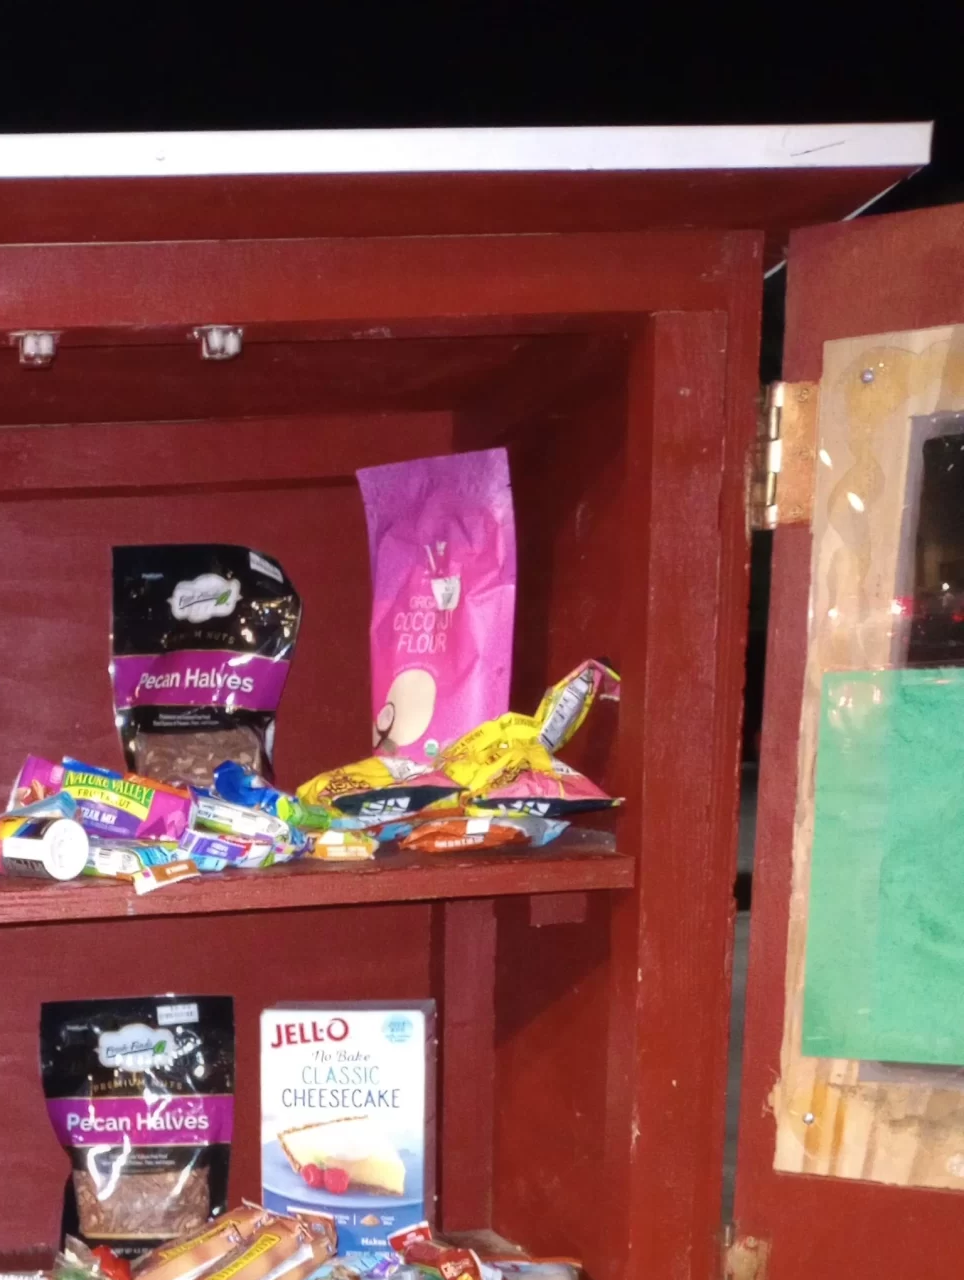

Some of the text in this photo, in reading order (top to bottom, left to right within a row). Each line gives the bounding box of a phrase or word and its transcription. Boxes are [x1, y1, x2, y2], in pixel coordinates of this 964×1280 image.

[396, 633, 447, 654] FLOUR
[139, 667, 255, 693] Pecan Halves
[65, 770, 150, 805] NATURE VALLEY
[101, 812, 118, 825] MIX
[311, 1050, 371, 1063] No Bake
[92, 1077, 145, 1093] PREMIUM
[301, 1066, 380, 1086] CLASSIC
[281, 1088, 401, 1109] CHEESECAKE
[66, 1111, 210, 1132] Pecan Halves
